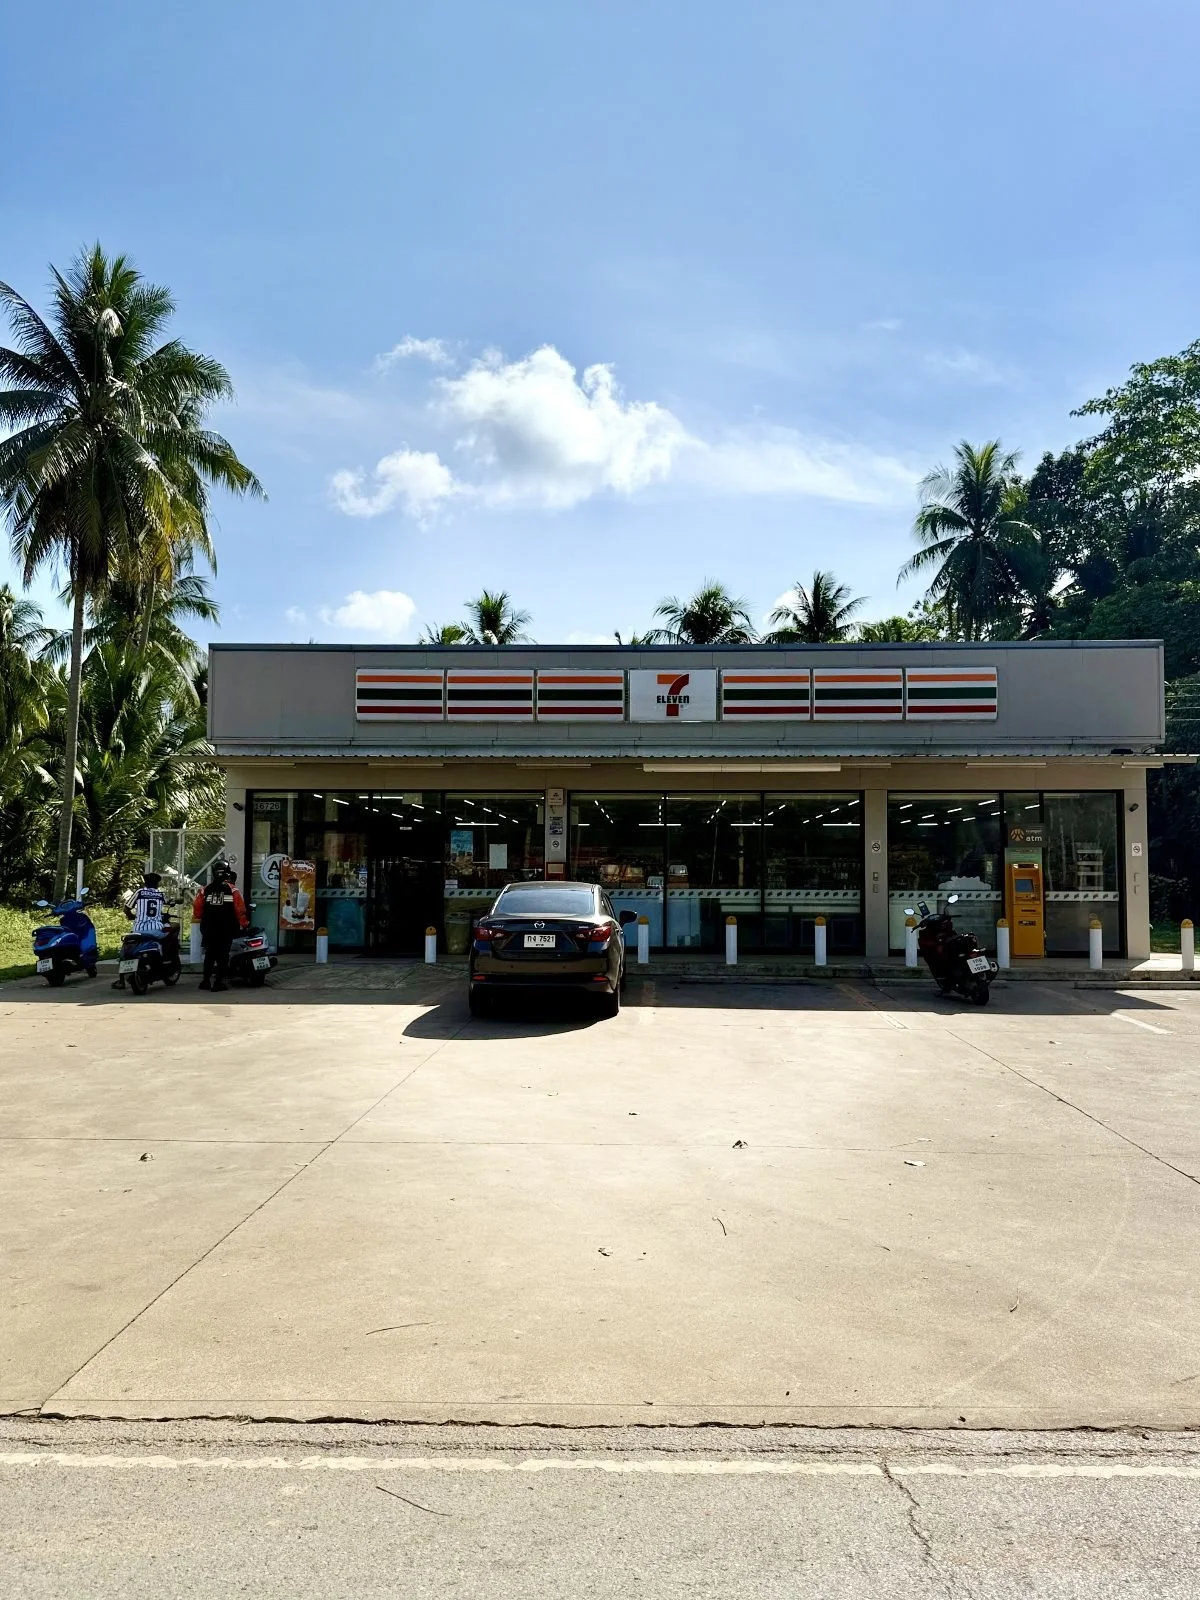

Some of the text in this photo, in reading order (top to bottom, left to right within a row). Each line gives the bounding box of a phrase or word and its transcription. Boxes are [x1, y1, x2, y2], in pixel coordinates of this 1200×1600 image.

[656, 673, 690, 717] 7
[146, 899, 158, 918] 6
[539, 935, 555, 943] 7521
